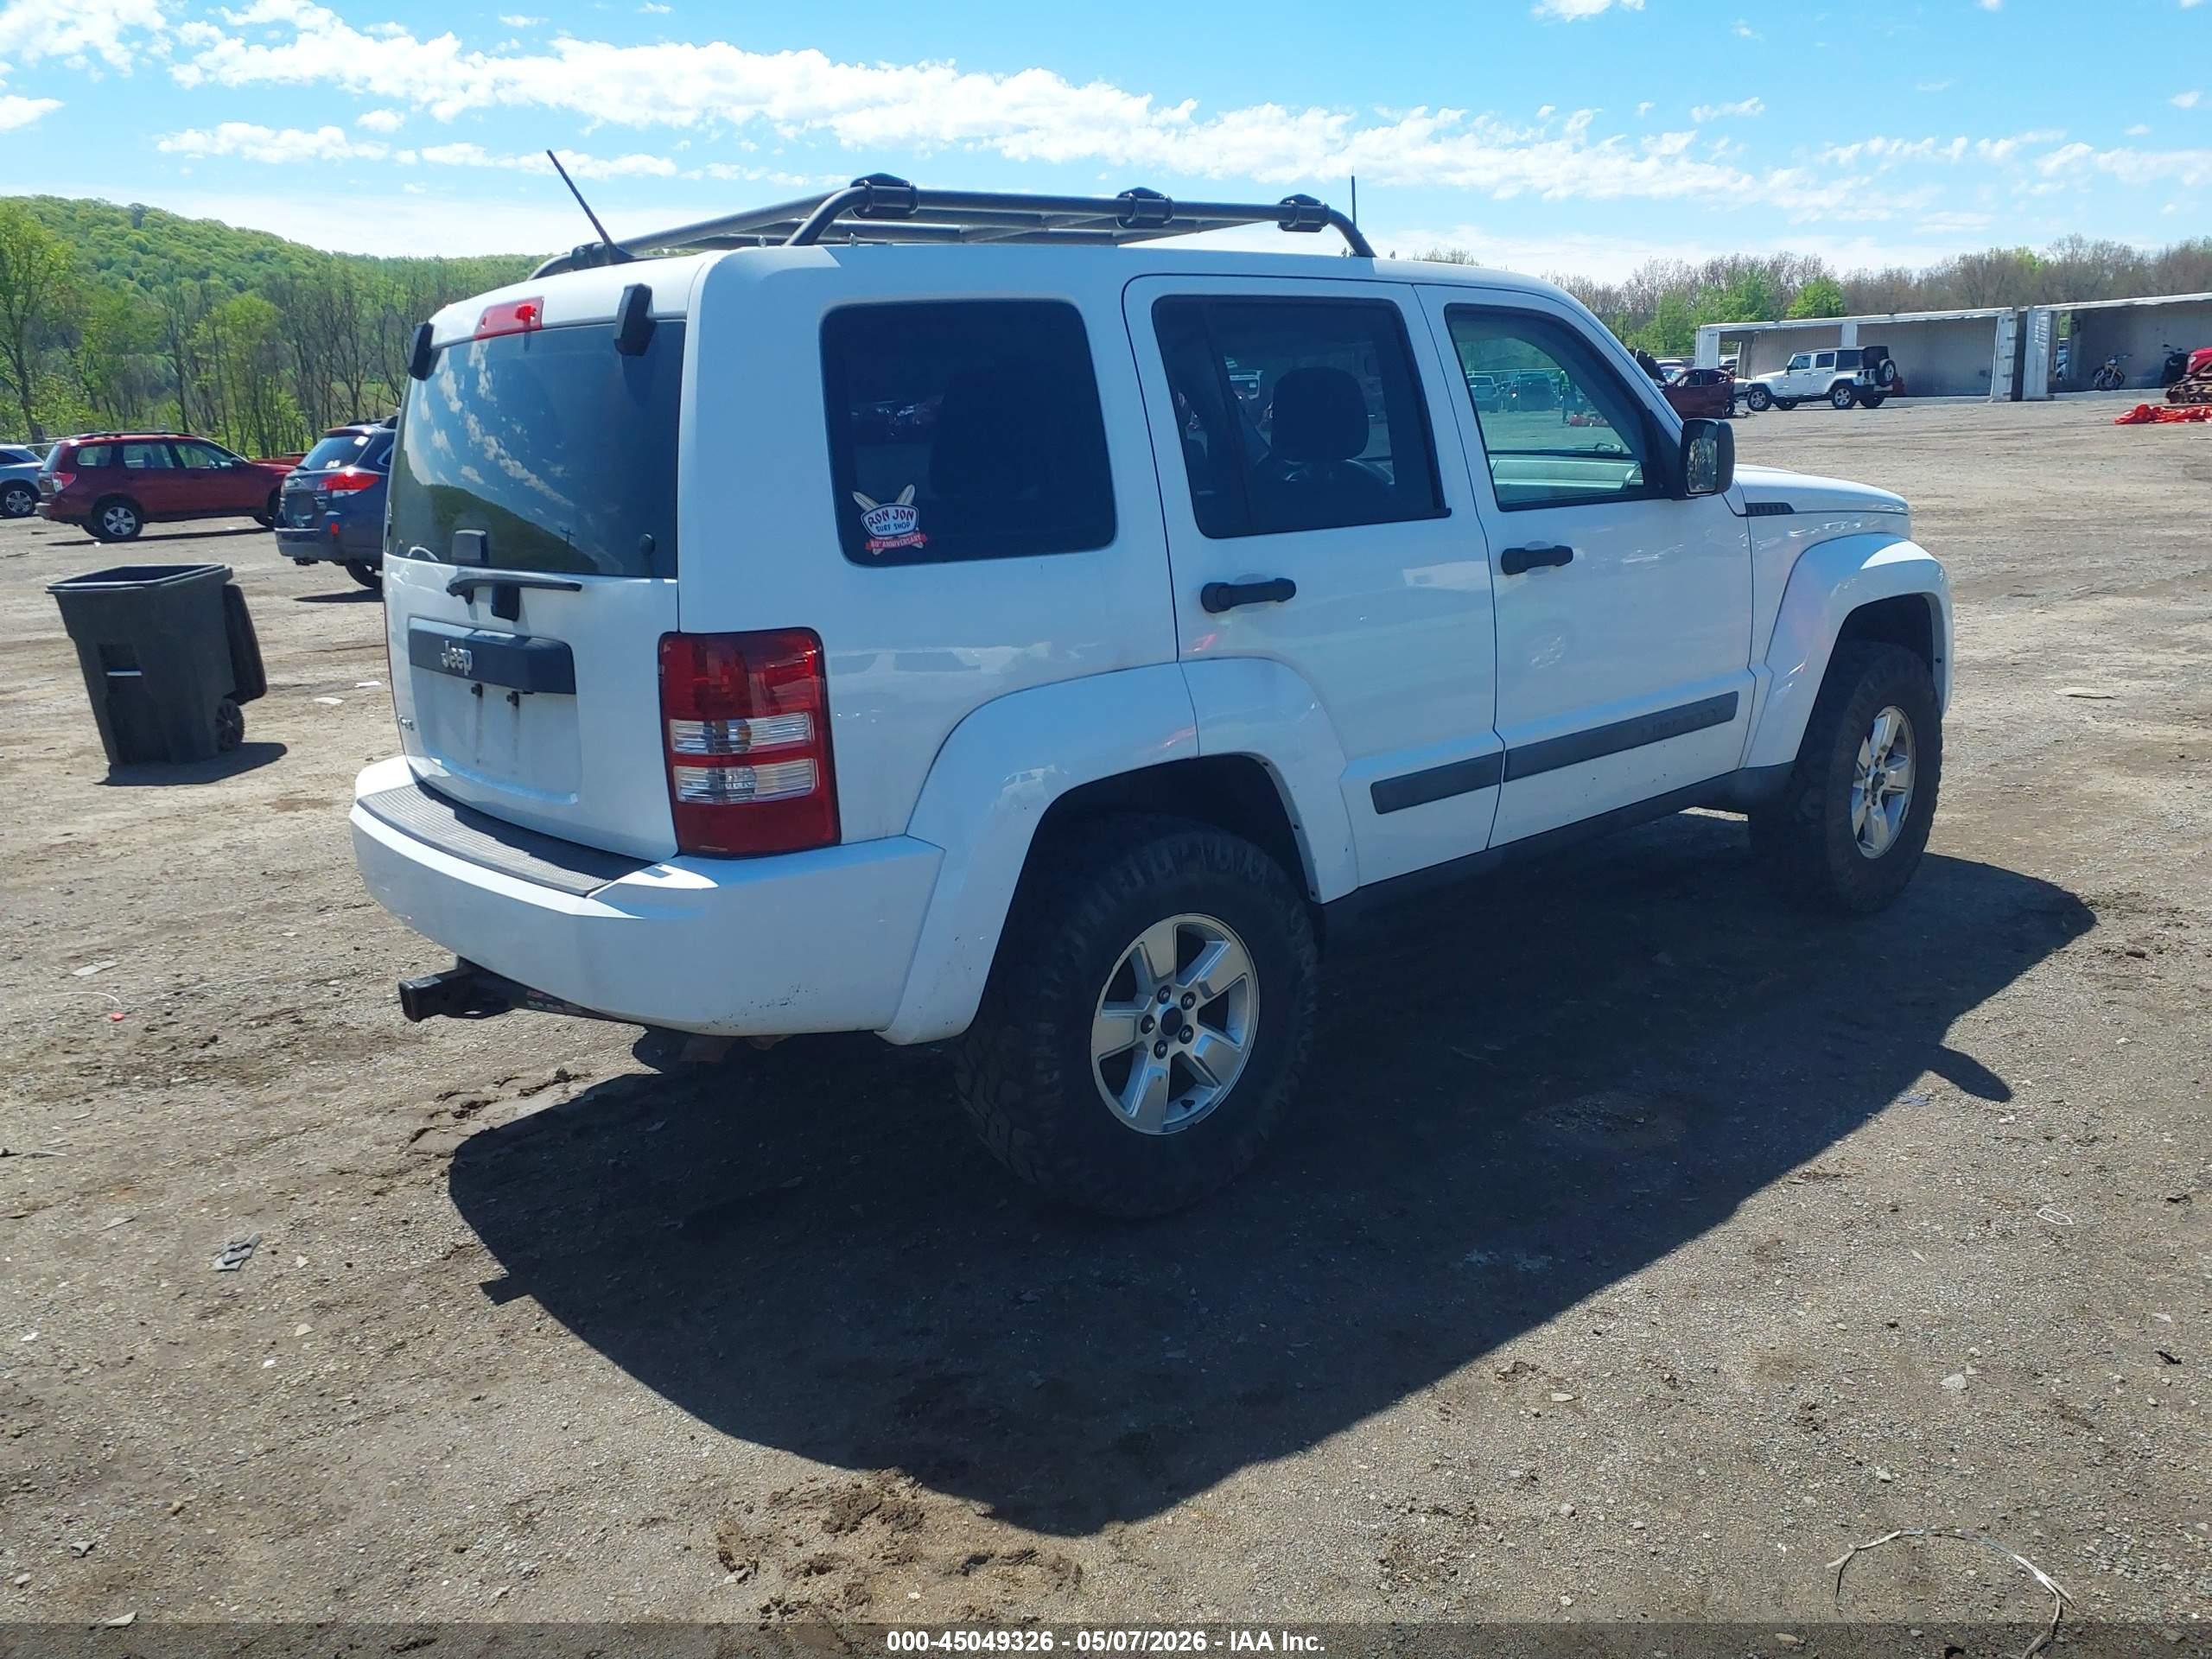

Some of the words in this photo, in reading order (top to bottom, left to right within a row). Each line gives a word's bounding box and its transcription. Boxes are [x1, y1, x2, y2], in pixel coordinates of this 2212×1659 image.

[868, 510, 889, 527] RON
[893, 509, 913, 521] JON
[875, 524, 890, 532] SURF
[893, 522, 910, 531] SHOP
[441, 640, 473, 676] Jeep
